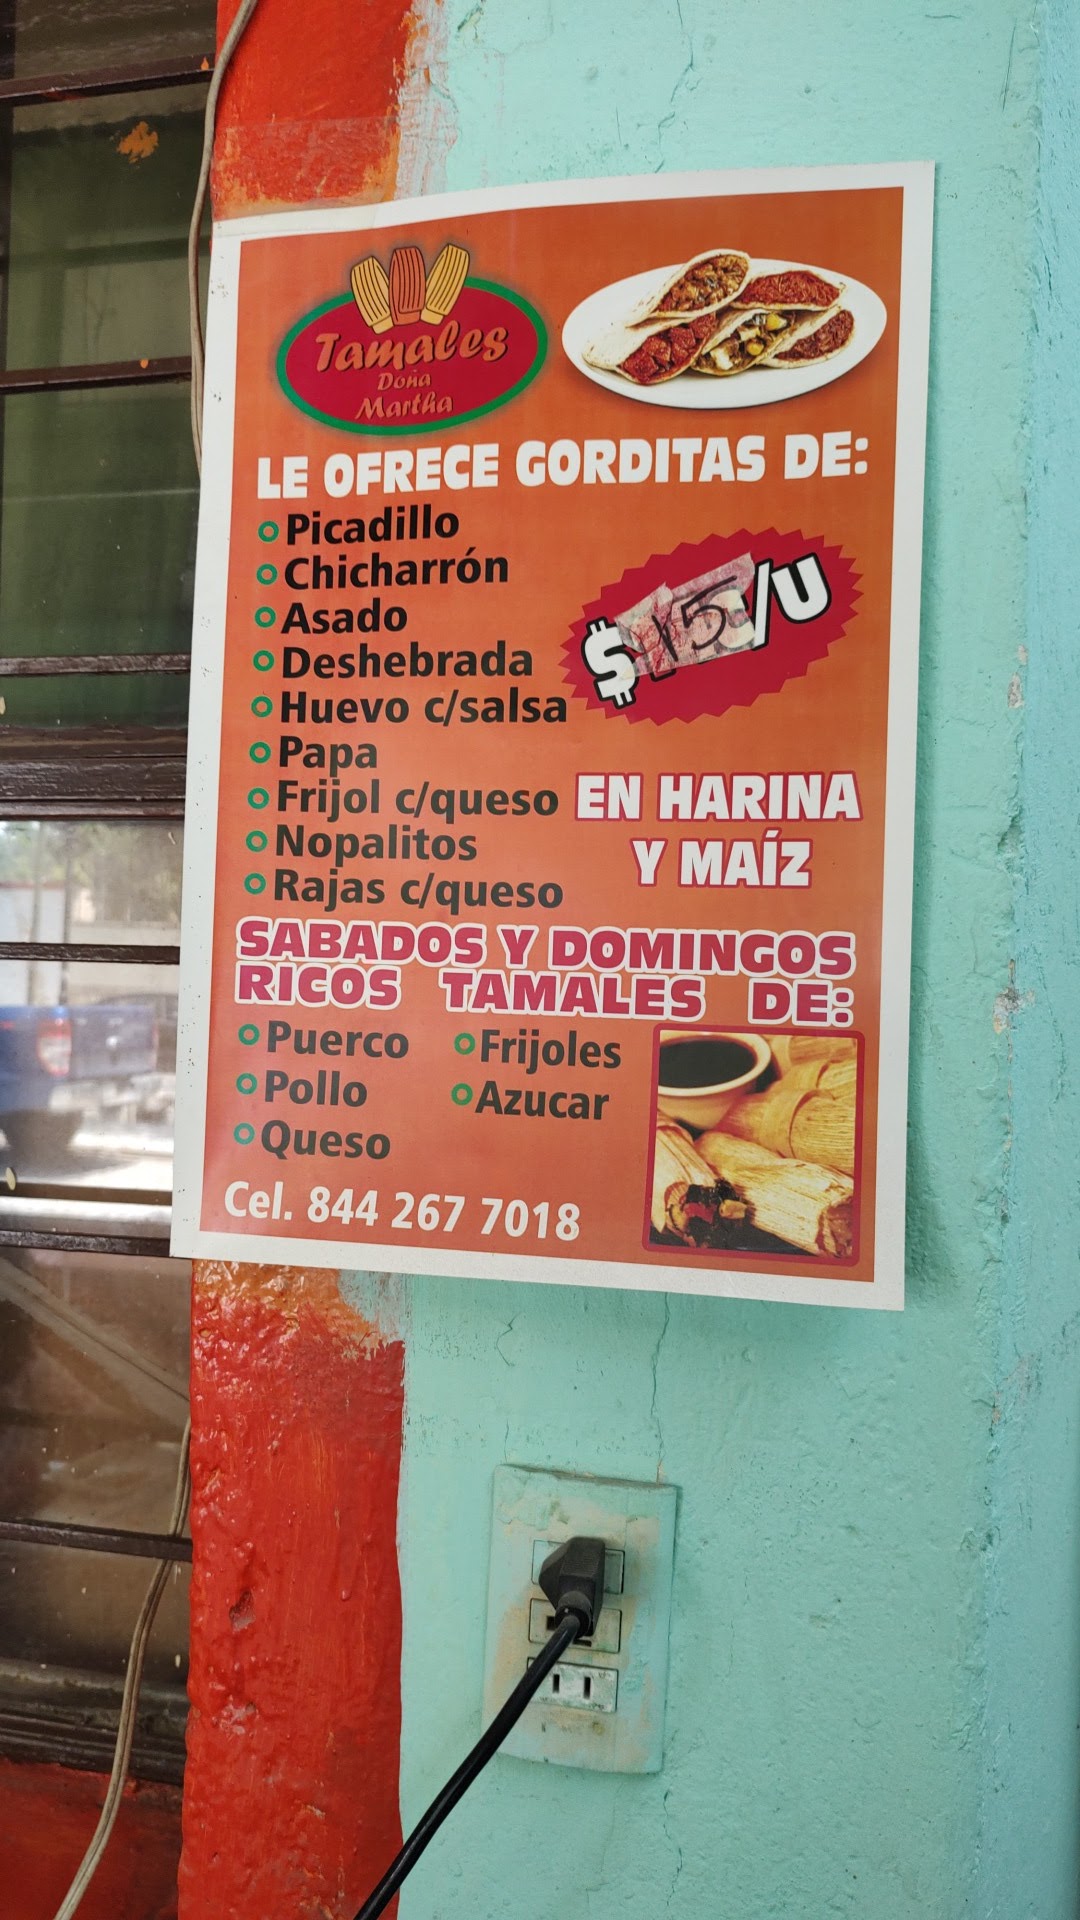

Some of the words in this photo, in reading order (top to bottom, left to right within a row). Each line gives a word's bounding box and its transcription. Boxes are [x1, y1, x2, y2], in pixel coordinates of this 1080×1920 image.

[315, 319, 508, 373] Tamales
[354, 391, 453, 420] Martha
[257, 457, 309, 499] LE
[324, 444, 500, 496] OFRECE
[515, 435, 766, 487] GORDITAS
[783, 431, 869, 480] DE:
[287, 505, 460, 546] Picadillo
[284, 547, 509, 590] Chicharrón
[281, 602, 408, 635] Asado
[282, 641, 533, 680] Deshebrada
[280, 691, 410, 725] Huevo
[424, 687, 568, 726] c/salsa
[279, 736, 378, 776] Papa
[277, 778, 381, 822] Frijol
[395, 782, 559, 823] c/queso
[576, 775, 640, 819] EN
[658, 775, 860, 820] HARINA
[275, 823, 478, 867] Nopalitos
[634, 840, 666, 885] Y
[680, 831, 810, 886] MAÍZ
[273, 869, 385, 909] Rajas
[400, 873, 564, 914] c/queso
[237, 919, 486, 966] SABADOS
[500, 927, 538, 966] Y
[549, 930, 854, 976] DOMINGOS
[237, 965, 400, 1007] RICOS
[441, 970, 704, 1019] TAMALES
[747, 980, 854, 1027] DE:
[267, 1020, 410, 1060] Puerco
[481, 1029, 622, 1074] Frijoles
[264, 1070, 368, 1107] Pollo
[475, 1081, 610, 1121] Azucar
[262, 1119, 391, 1166] Queso
[223, 1180, 294, 1220] Cel.
[307, 1186, 379, 1227] 844
[391, 1191, 466, 1234] 267
[480, 1198, 581, 1242] 7018
